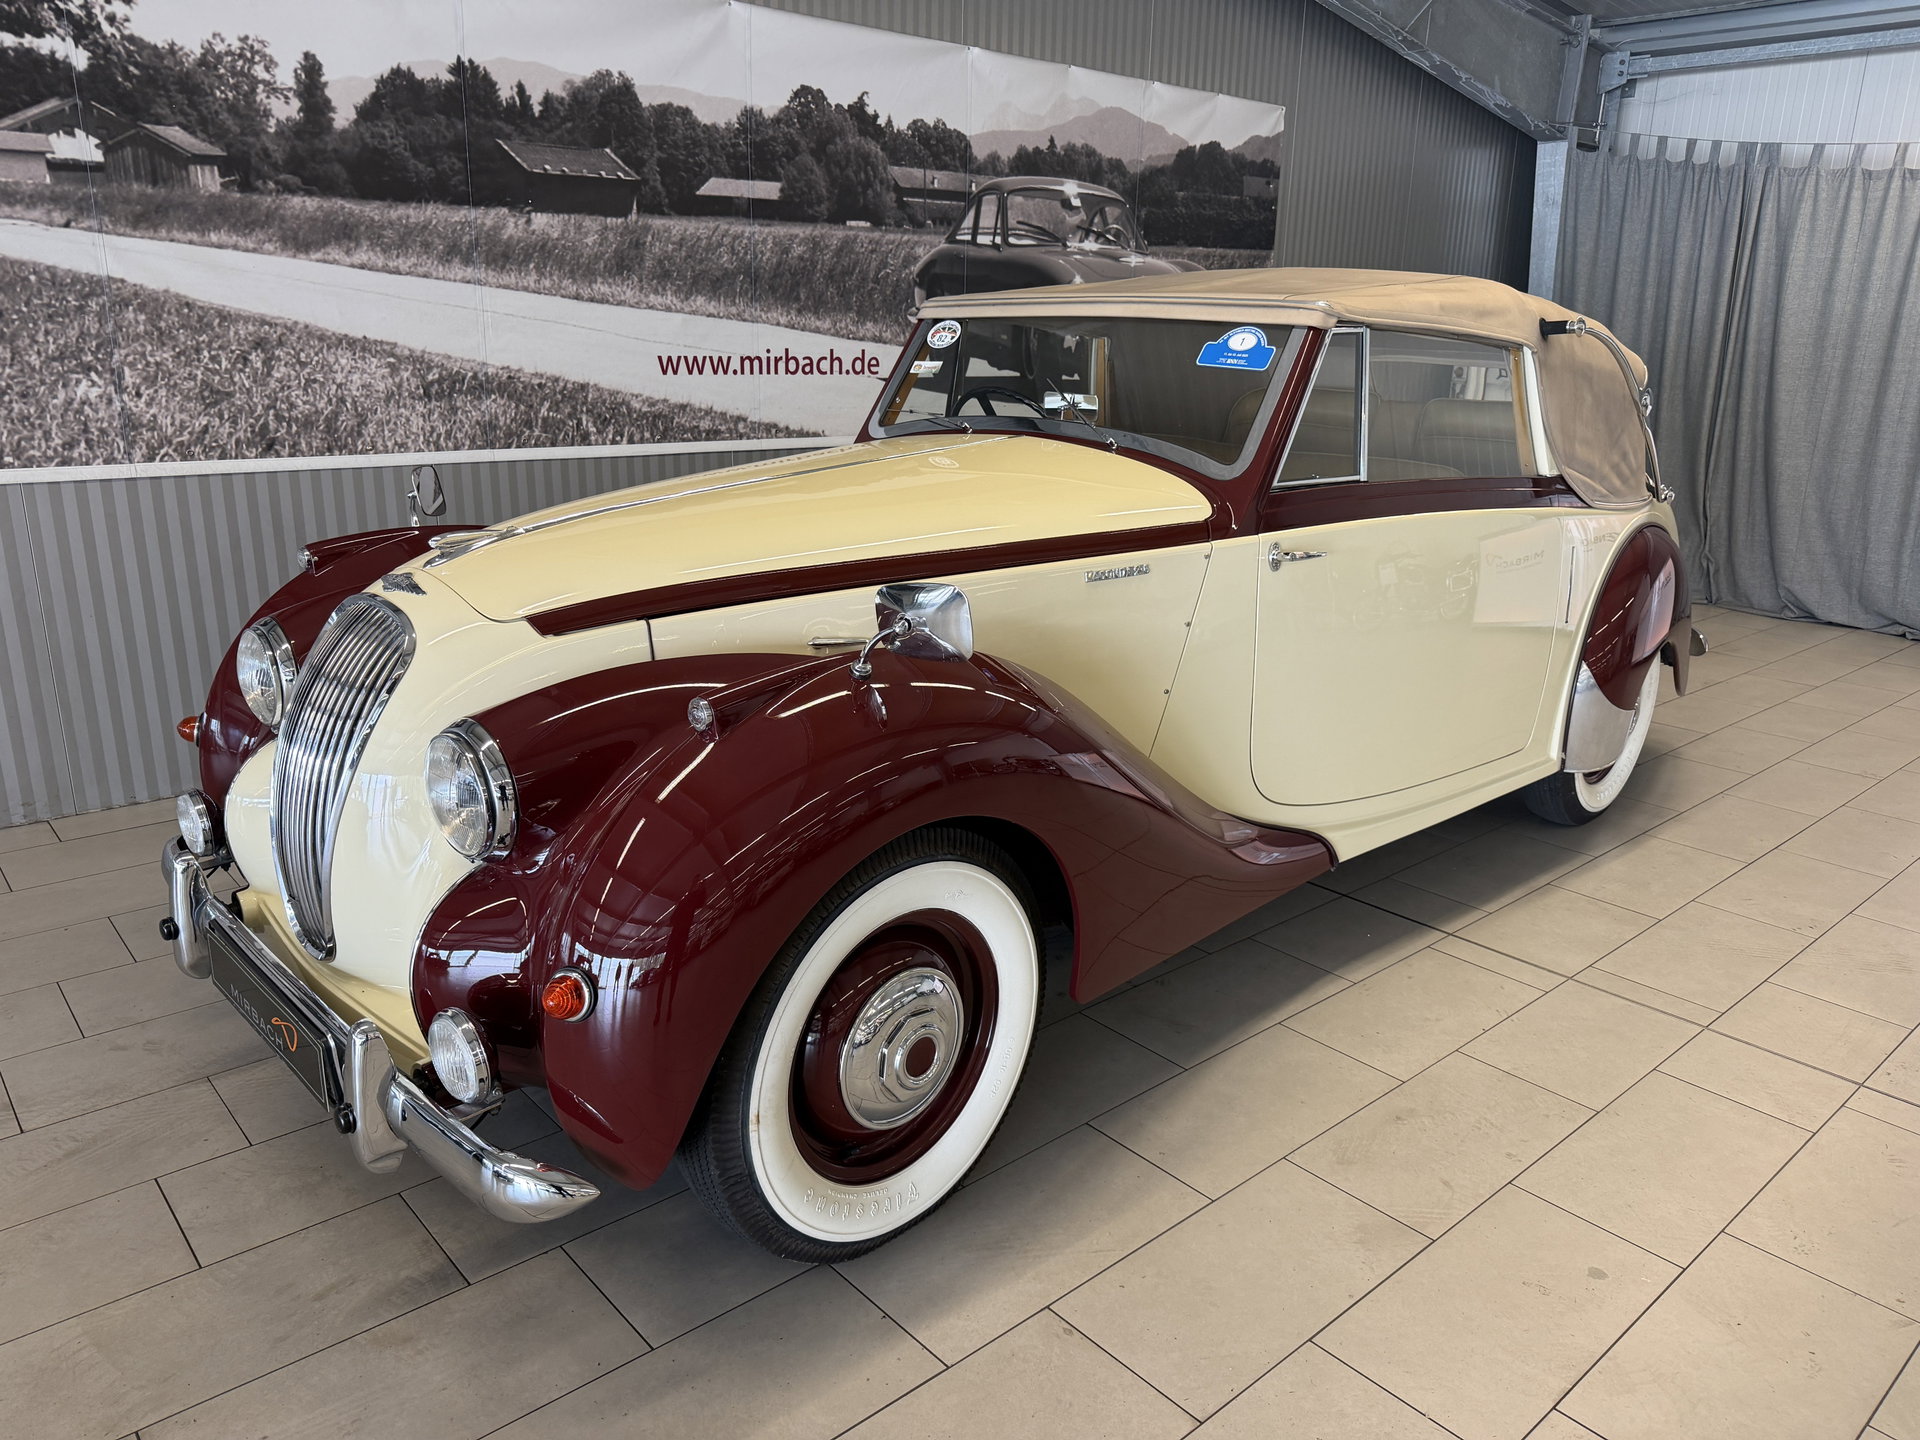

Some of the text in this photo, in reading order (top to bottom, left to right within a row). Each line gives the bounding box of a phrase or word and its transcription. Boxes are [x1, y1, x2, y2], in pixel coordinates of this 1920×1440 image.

[936, 334, 948, 343] 82
[657, 348, 880, 376] www.mirbach.de
[230, 983, 284, 1051] MIRBACH
